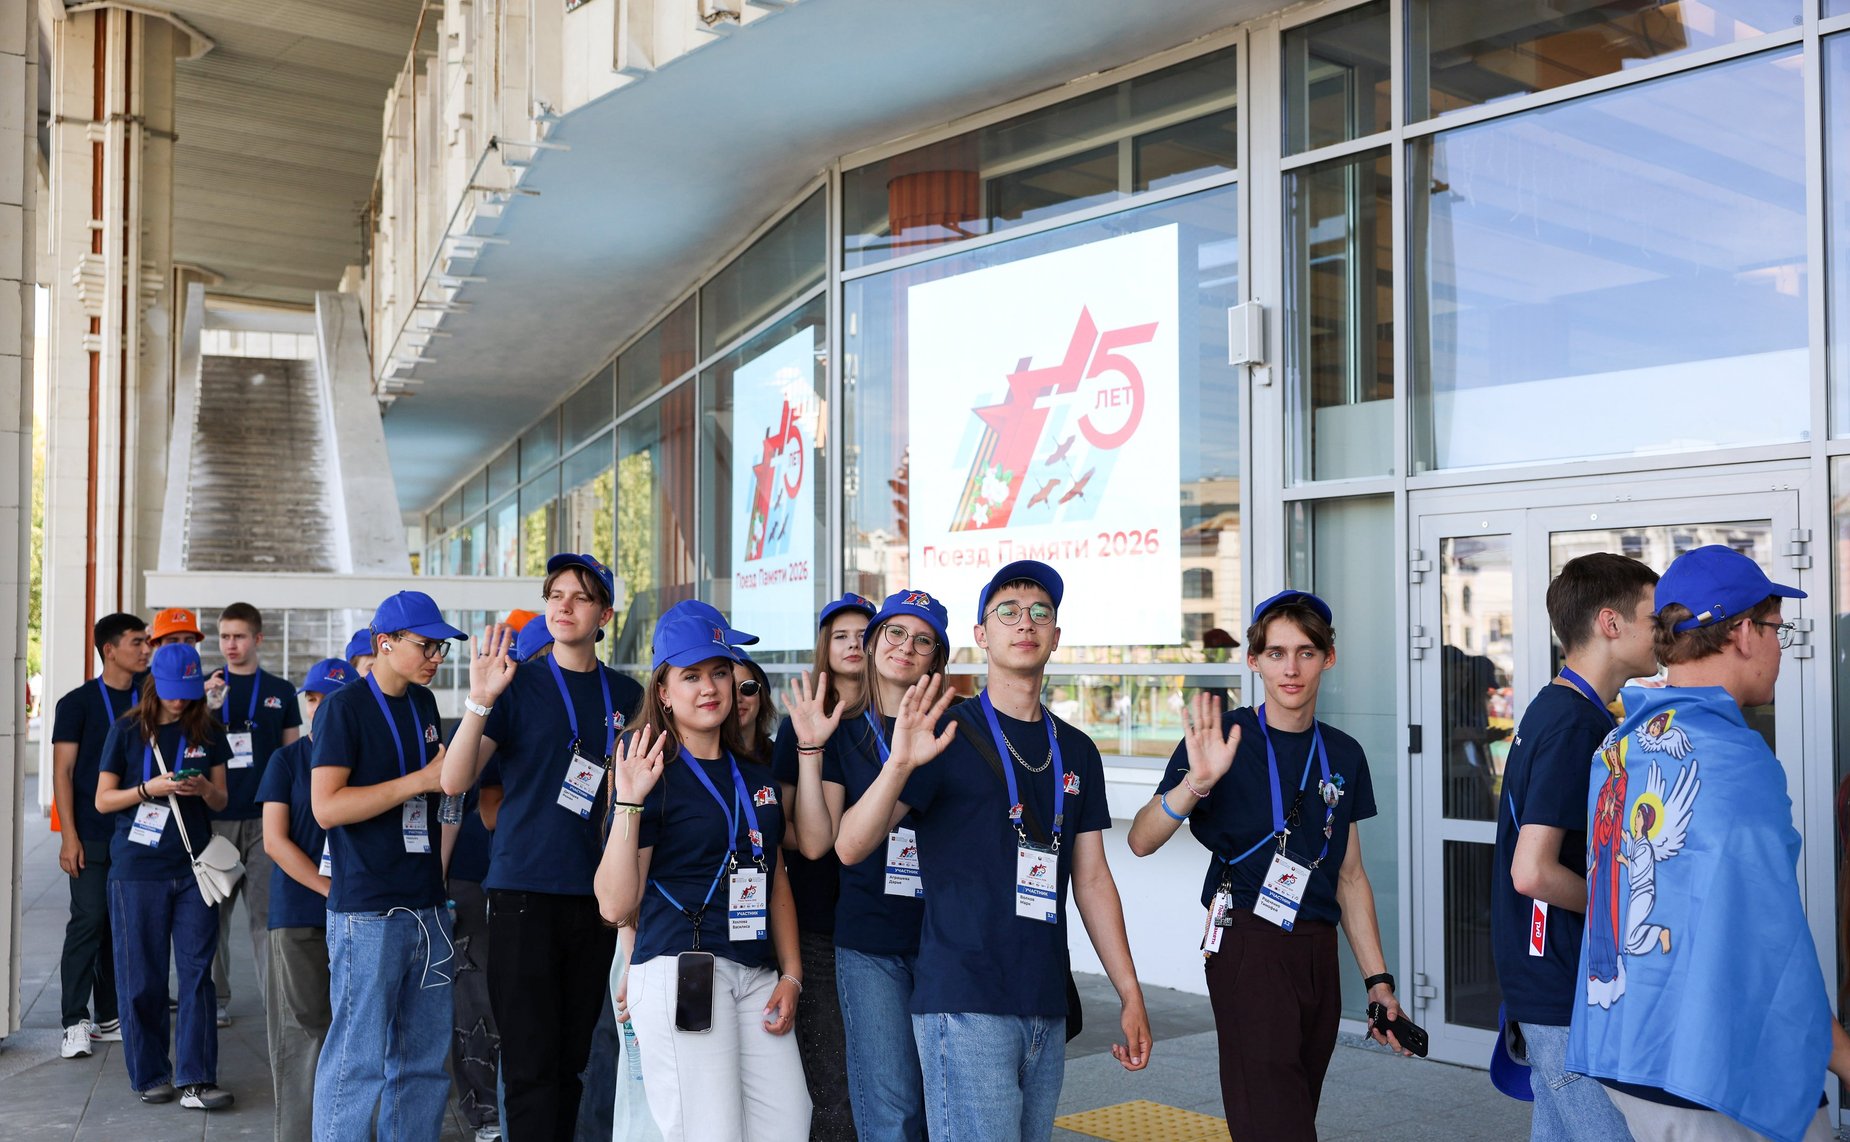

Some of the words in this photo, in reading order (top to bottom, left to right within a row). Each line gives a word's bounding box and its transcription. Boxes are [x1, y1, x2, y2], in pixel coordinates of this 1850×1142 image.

[1094, 386, 1133, 409] ЛЕТ
[923, 545, 990, 568] Поезд
[998, 539, 1089, 561] Памяти
[1097, 528, 1159, 557] 2026
[736, 572, 756, 589] Поезд
[759, 568, 787, 586] Памяти
[789, 560, 808, 582] 2026
[570, 786, 588, 797] УЧАСТНИК
[1024, 887, 1049, 896] УЧАСТНИК
[1269, 890, 1292, 906] УЧАСТНИК
